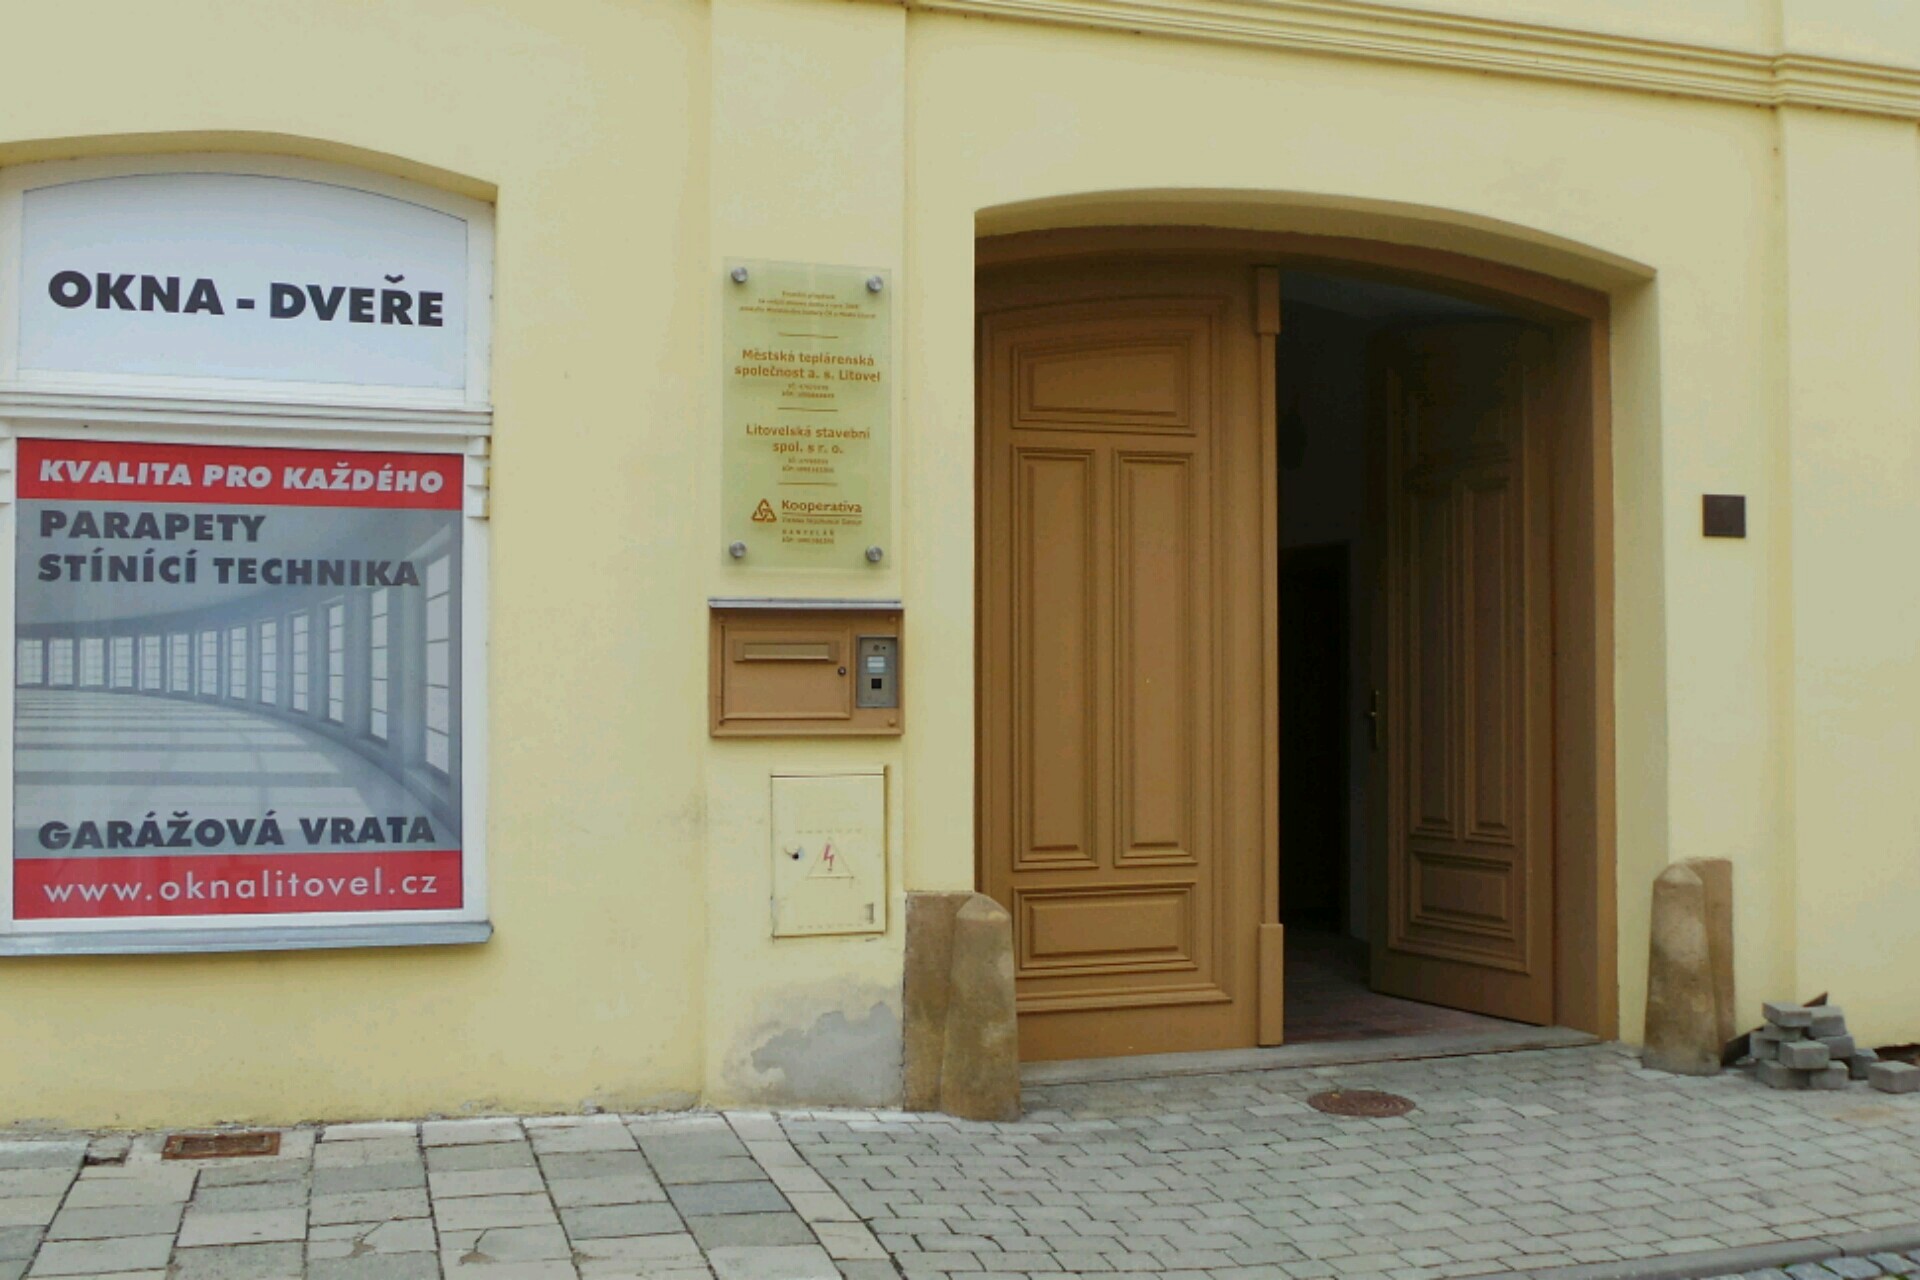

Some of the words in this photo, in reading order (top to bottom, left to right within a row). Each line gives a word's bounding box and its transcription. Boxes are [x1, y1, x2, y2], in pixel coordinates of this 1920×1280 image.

[49, 270, 224, 315] OKNA
[237, 297, 255, 310] -
[270, 274, 444, 327] DVEŘE
[742, 348, 795, 363] Městská
[799, 352, 874, 367] teplárenská
[734, 365, 804, 379] společnost
[807, 370, 819, 379] a.
[823, 371, 834, 380] s.
[839, 370, 880, 383] Litovel
[746, 424, 811, 438] Litovelská
[815, 427, 870, 439] stavební
[773, 441, 803, 453] spol.
[808, 444, 815, 452] s
[818, 444, 828, 453] r.
[831, 445, 843, 454] o.
[40, 459, 191, 487] KVALITA
[203, 465, 271, 488] PRO
[283, 462, 444, 493] KAŽDÉHO
[782, 499, 862, 514] Kooperativa
[40, 510, 266, 542] PARAPETY
[38, 547, 197, 583] STÍNÍCÍ
[213, 557, 420, 586] TECHNIKA
[38, 811, 285, 849] GARÁŽOVÁ
[299, 816, 436, 844] VRATA
[43, 867, 438, 903] www.oknalitovel.cz
